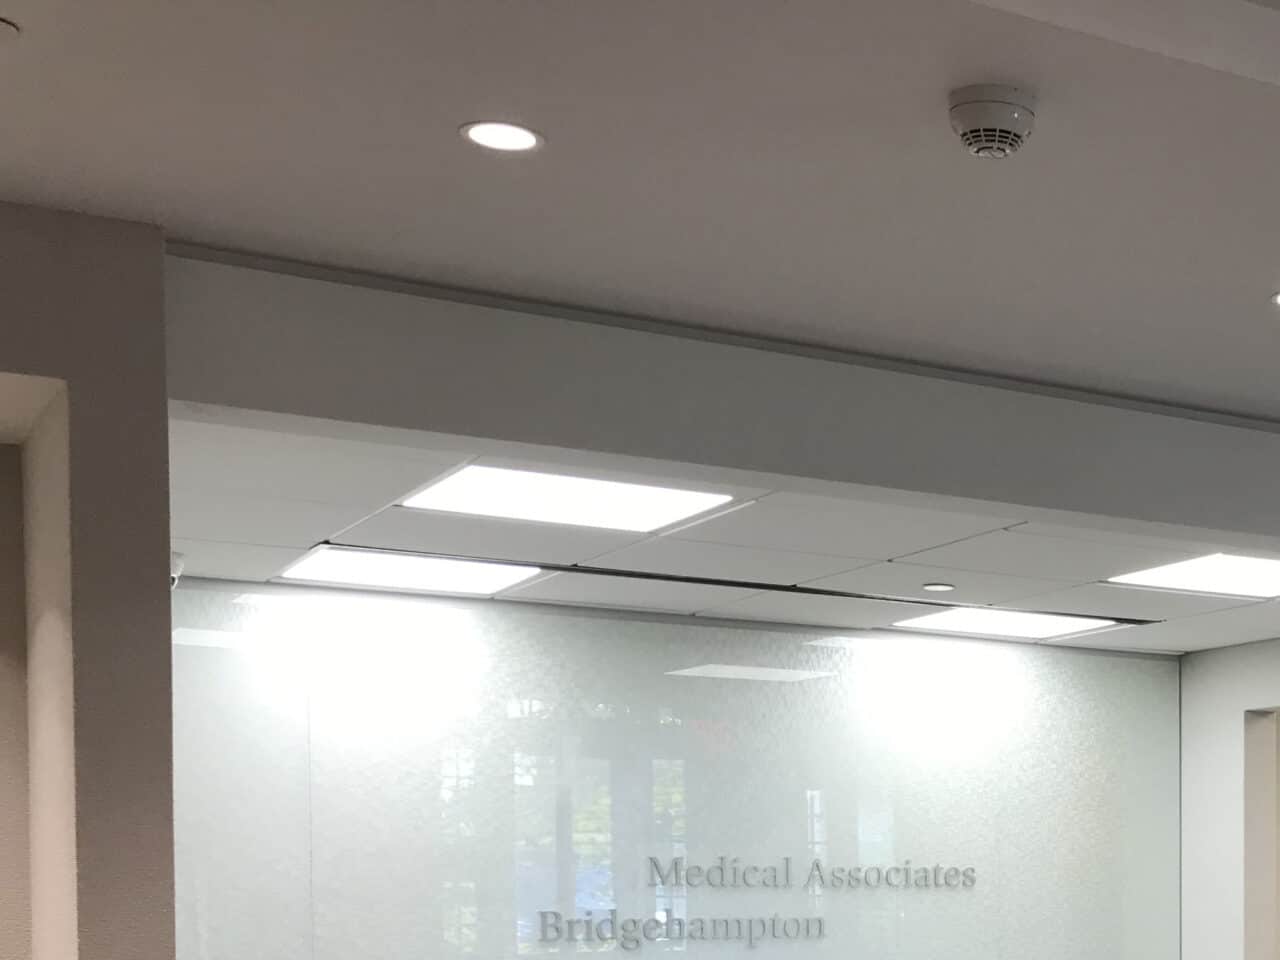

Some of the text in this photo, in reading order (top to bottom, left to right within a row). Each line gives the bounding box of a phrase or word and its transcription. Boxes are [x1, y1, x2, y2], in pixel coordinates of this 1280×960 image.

[647, 856, 977, 889] Medical Associates
[537, 909, 826, 950] Bridgehampton
